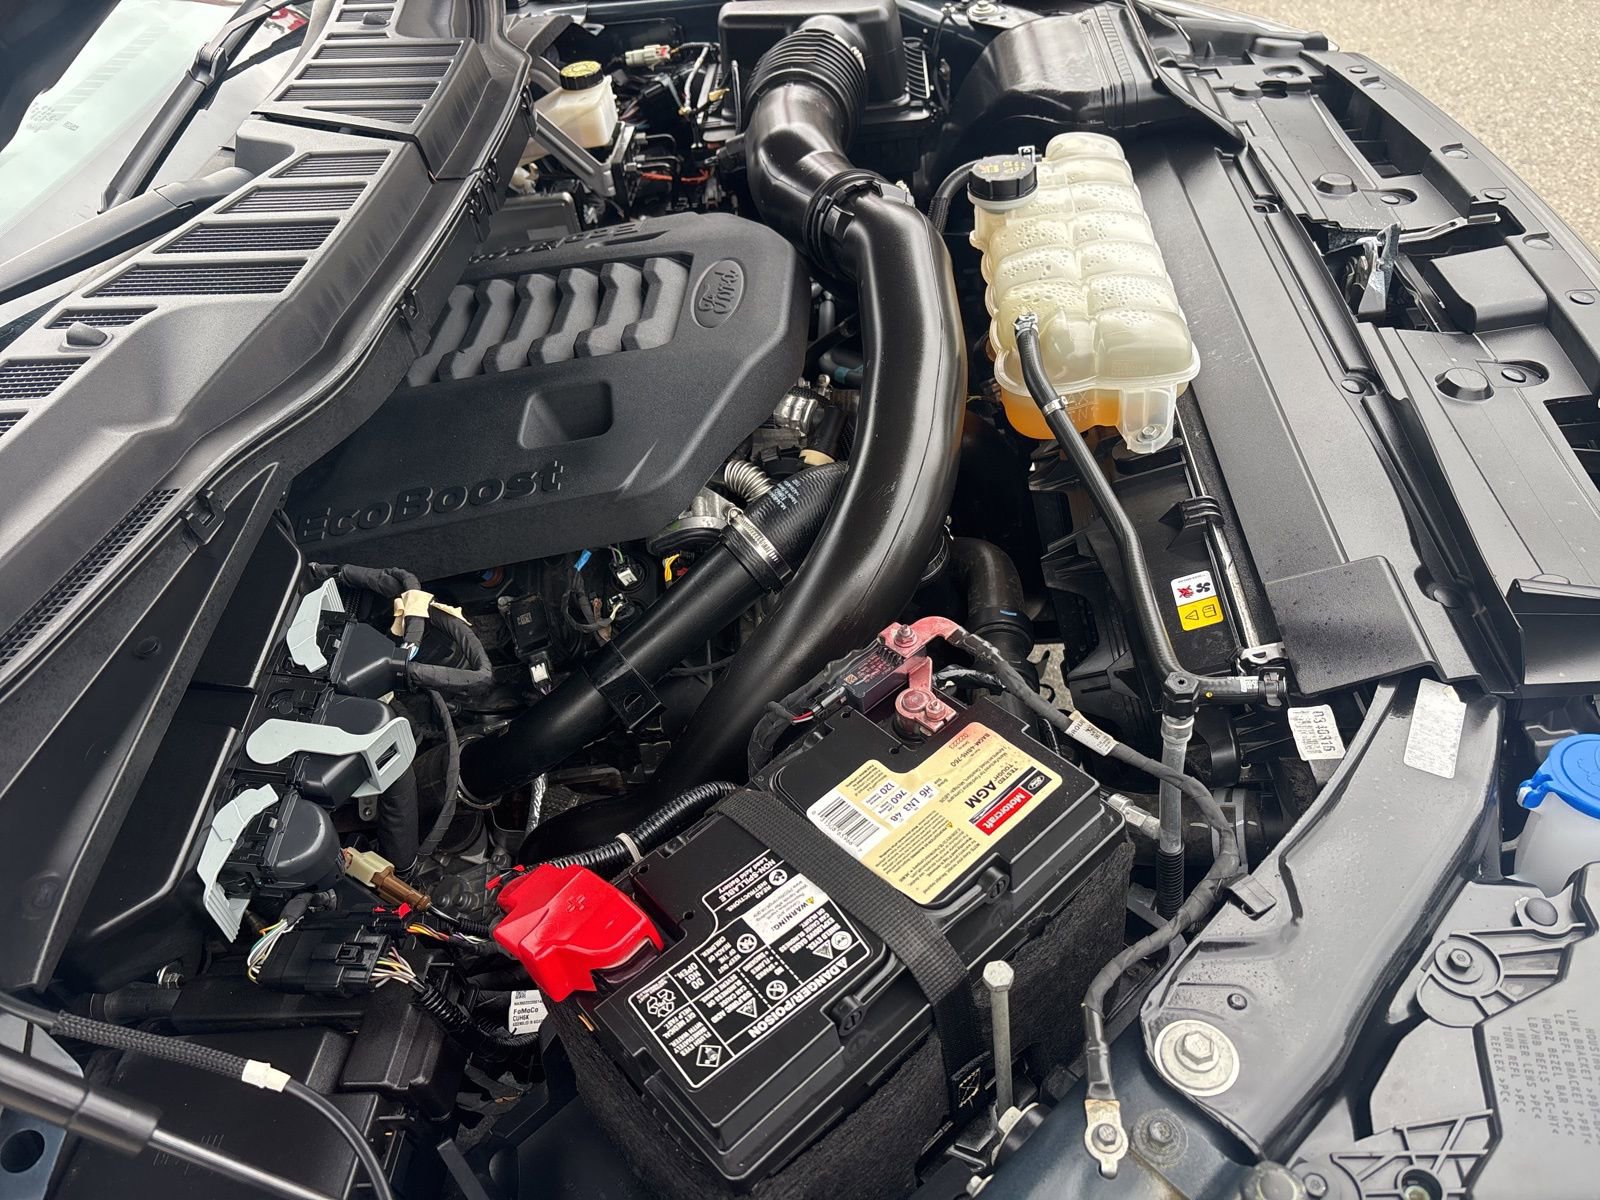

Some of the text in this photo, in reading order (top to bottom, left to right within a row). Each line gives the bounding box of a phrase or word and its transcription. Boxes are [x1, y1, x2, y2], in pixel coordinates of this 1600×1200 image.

[696, 266, 741, 319] Ford
[296, 461, 564, 544] EcoBoost
[878, 782, 895, 795] 120
[997, 766, 1018, 784] TESTED
[1026, 774, 1044, 790] Ford
[888, 789, 908, 804] 760
[889, 785, 934, 822] H6 LN3 48
[963, 780, 998, 809] AGM
[982, 791, 1026, 830] Motorcraft
[717, 858, 776, 902] NON-SPILLABLE
[754, 883, 771, 899] READ
[724, 877, 767, 914] INSTRUCTIONS.
[770, 900, 808, 932] WARNING:
[706, 941, 731, 963] REACH OF
[716, 952, 741, 974] KEEP OUT
[717, 947, 736, 964] OF THE
[673, 959, 698, 982] OPEN.
[682, 968, 700, 985] NOT
[690, 976, 704, 990] DO
[773, 965, 784, 976] NO
[710, 989, 752, 1024] SULFURIC ACID
[718, 984, 747, 1008] CAN CAUSE
[747, 963, 840, 1038] DANGER/POISON
[661, 1010, 696, 1039] GET MEDICAL
[676, 1005, 692, 1020] HELP
[1490, 1036, 1505, 1072] REFLEX
[1502, 1026, 1514, 1049] TURN
[1508, 1056, 1521, 1079] REFL
[1558, 1031, 1572, 1054] REFL
[1567, 1009, 1579, 1033] LINK
[1574, 1038, 1592, 1082] BRACKET
[1516, 1029, 1530, 1057] INNER
[1523, 1064, 1537, 1088] LENS
[1535, 1052, 1550, 1083] REFLS
[1541, 1018, 1555, 1042] HORZ
[1548, 1048, 1563, 1077] BEZEL
[1556, 1085, 1569, 1104] BAR
[1564, 1061, 1585, 1105] BRACKET
